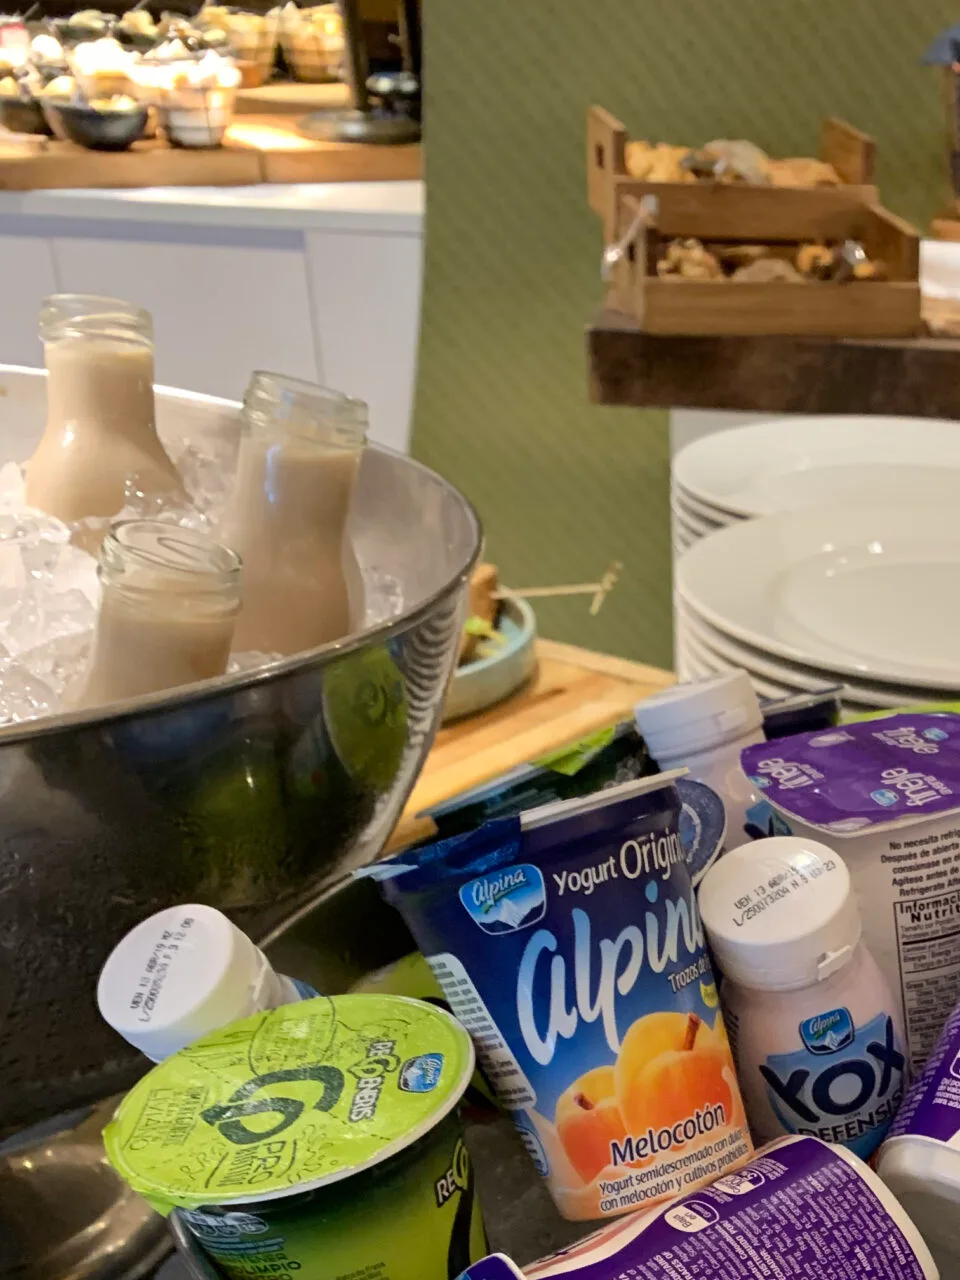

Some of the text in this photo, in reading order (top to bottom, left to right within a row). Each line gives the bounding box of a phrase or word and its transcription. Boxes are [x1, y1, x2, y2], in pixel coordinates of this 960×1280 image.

[552, 827, 684, 897] Yogurt Origin
[471, 868, 527, 907] Alpina
[667, 962, 698, 993] Trozos
[808, 1010, 841, 1036] Alpina
[610, 1103, 726, 1167] Melocotón
[600, 1173, 635, 1196] Yogurt
[635, 1146, 713, 1186] semidescremado
[713, 1136, 728, 1153] con
[600, 1196, 619, 1213] con
[619, 1176, 675, 1207] melocotón
[676, 1177, 683, 1192] y
[684, 1157, 718, 1184] cultivos
[735, 1234, 771, 1276] DISTRIBUIDO
